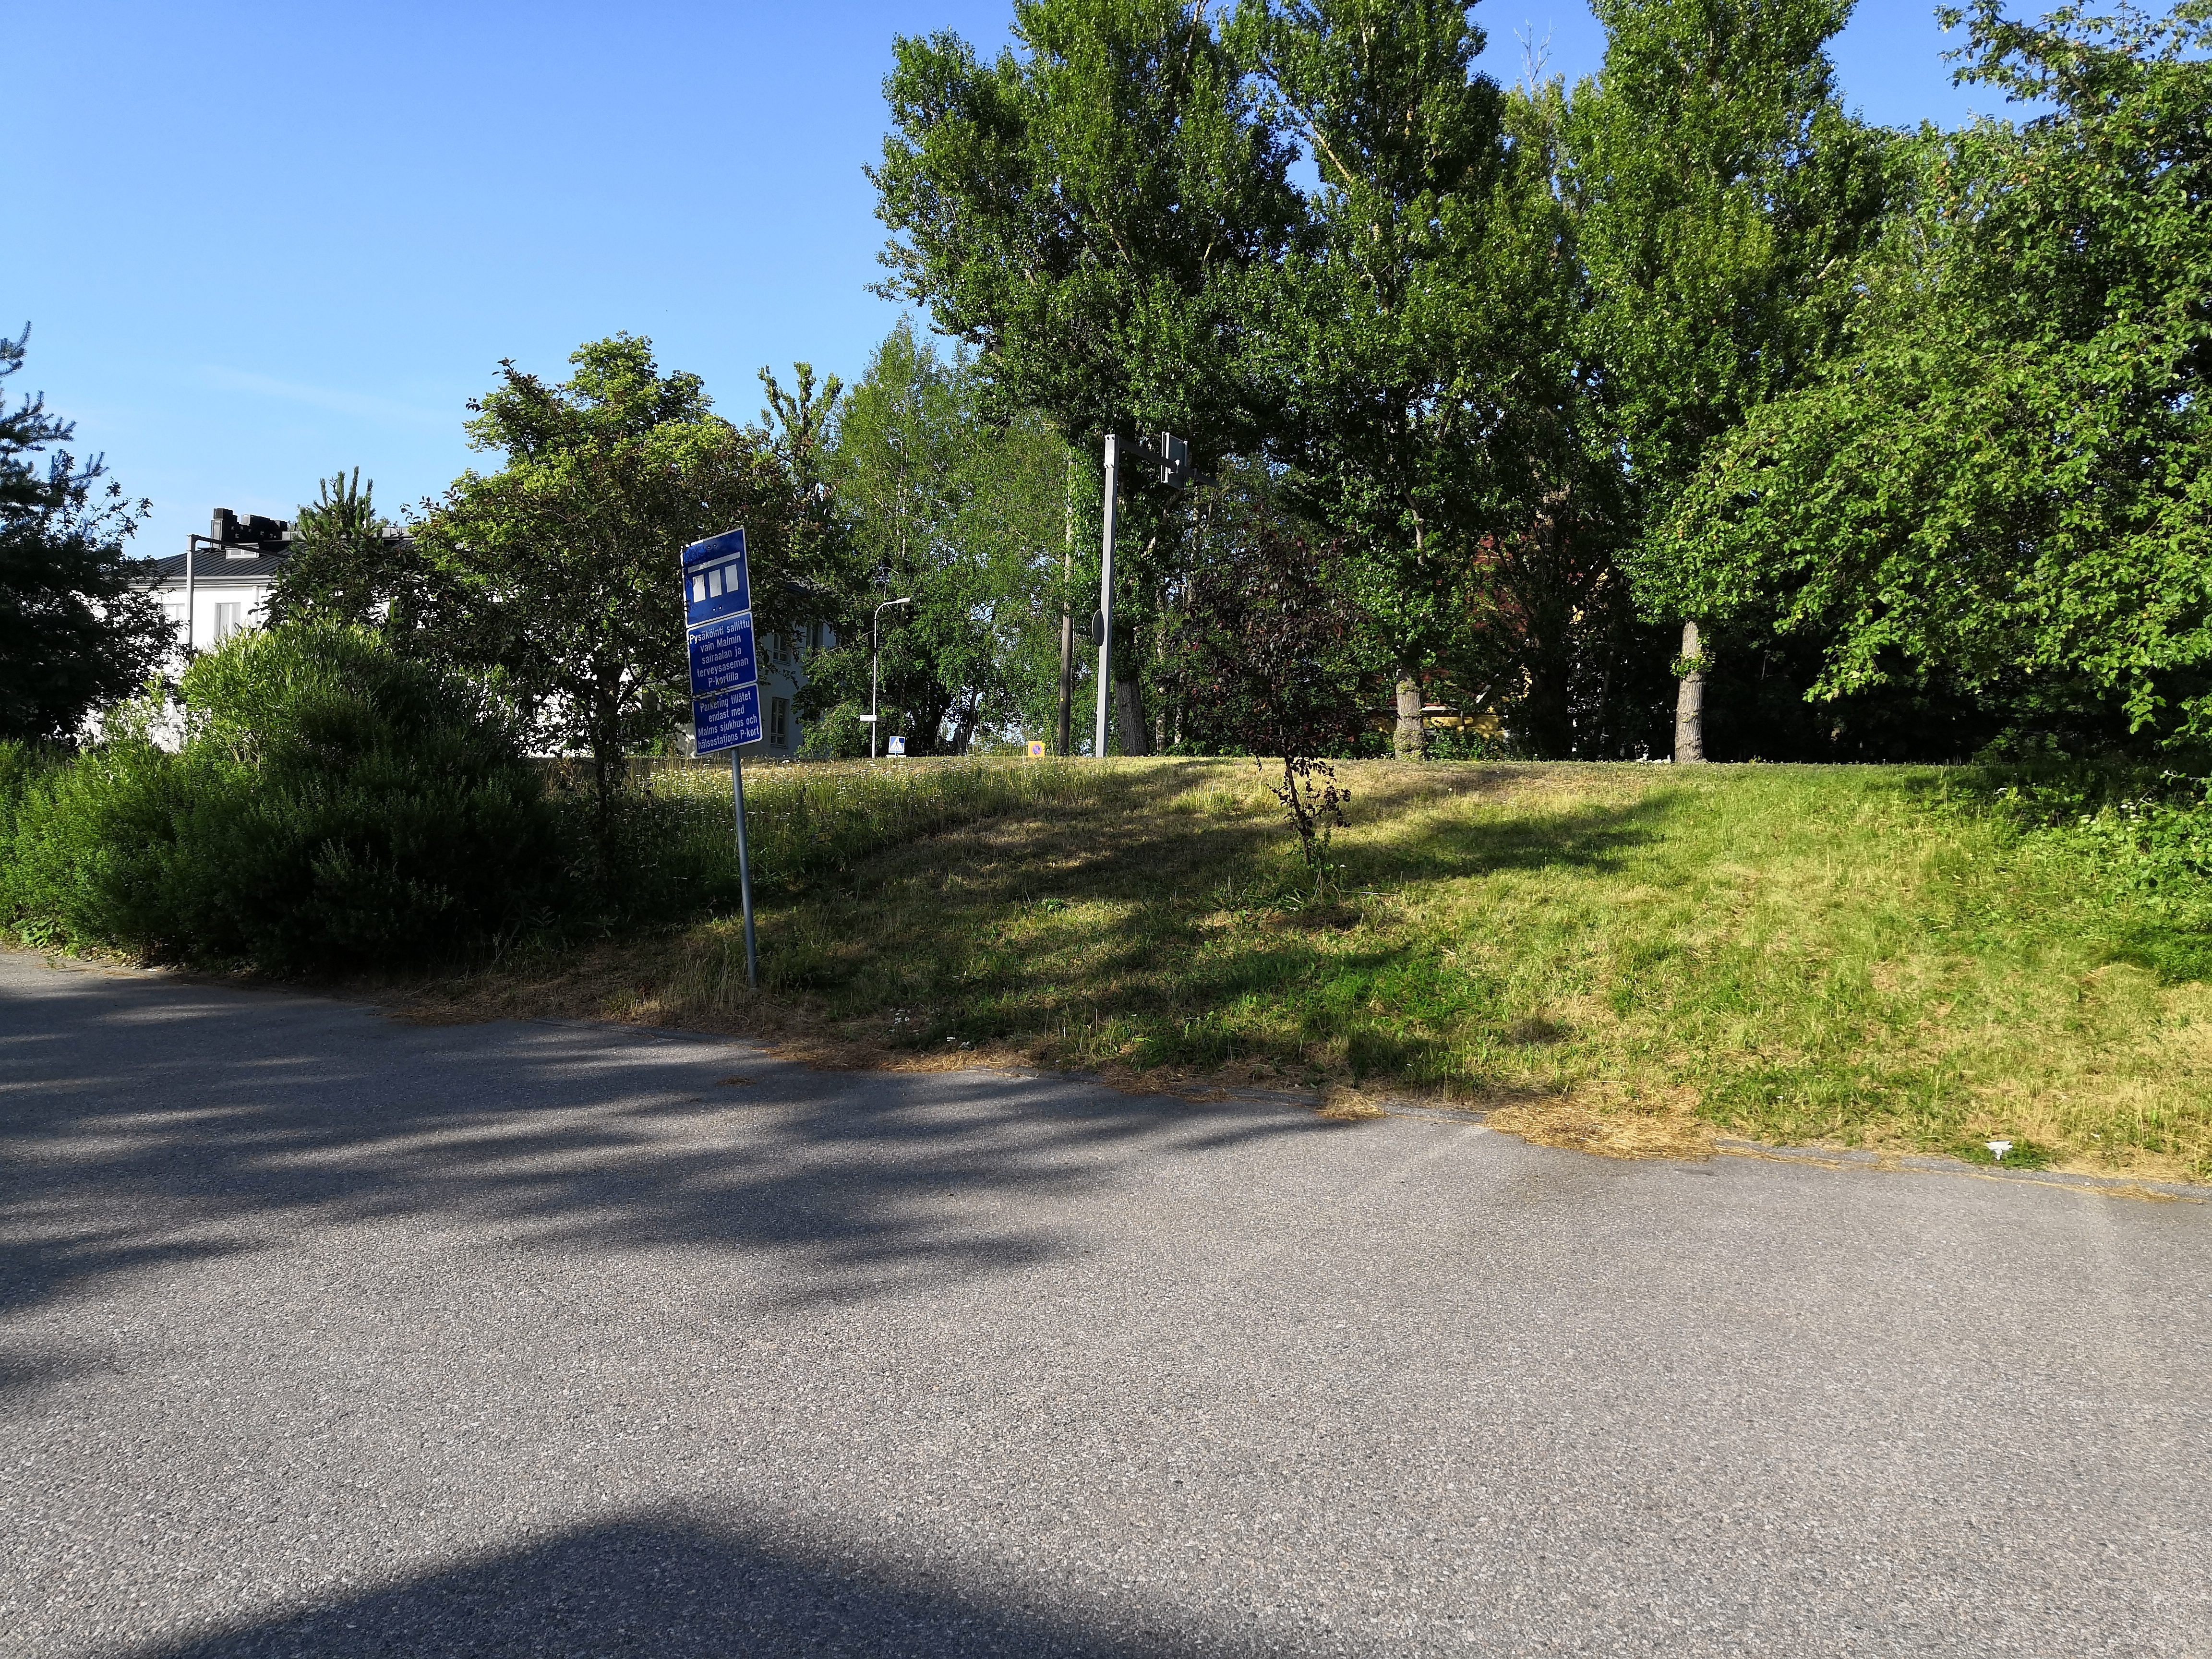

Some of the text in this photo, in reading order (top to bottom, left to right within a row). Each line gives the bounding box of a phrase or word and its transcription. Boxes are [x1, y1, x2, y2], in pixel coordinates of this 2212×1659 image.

[689, 620, 750, 644] Pysäköinti sallittu
[700, 634, 741, 653] vain Malmin
[702, 646, 742, 664] sairaalan ja
[697, 658, 749, 678] terveysaseman
[708, 672, 739, 687] P-kortilla
[700, 691, 751, 713] Parkering tillåtet
[709, 704, 745, 722] endast med
[698, 714, 757, 738] Malms sjukhus och
[698, 725, 759, 750] hälsostations P-kort
